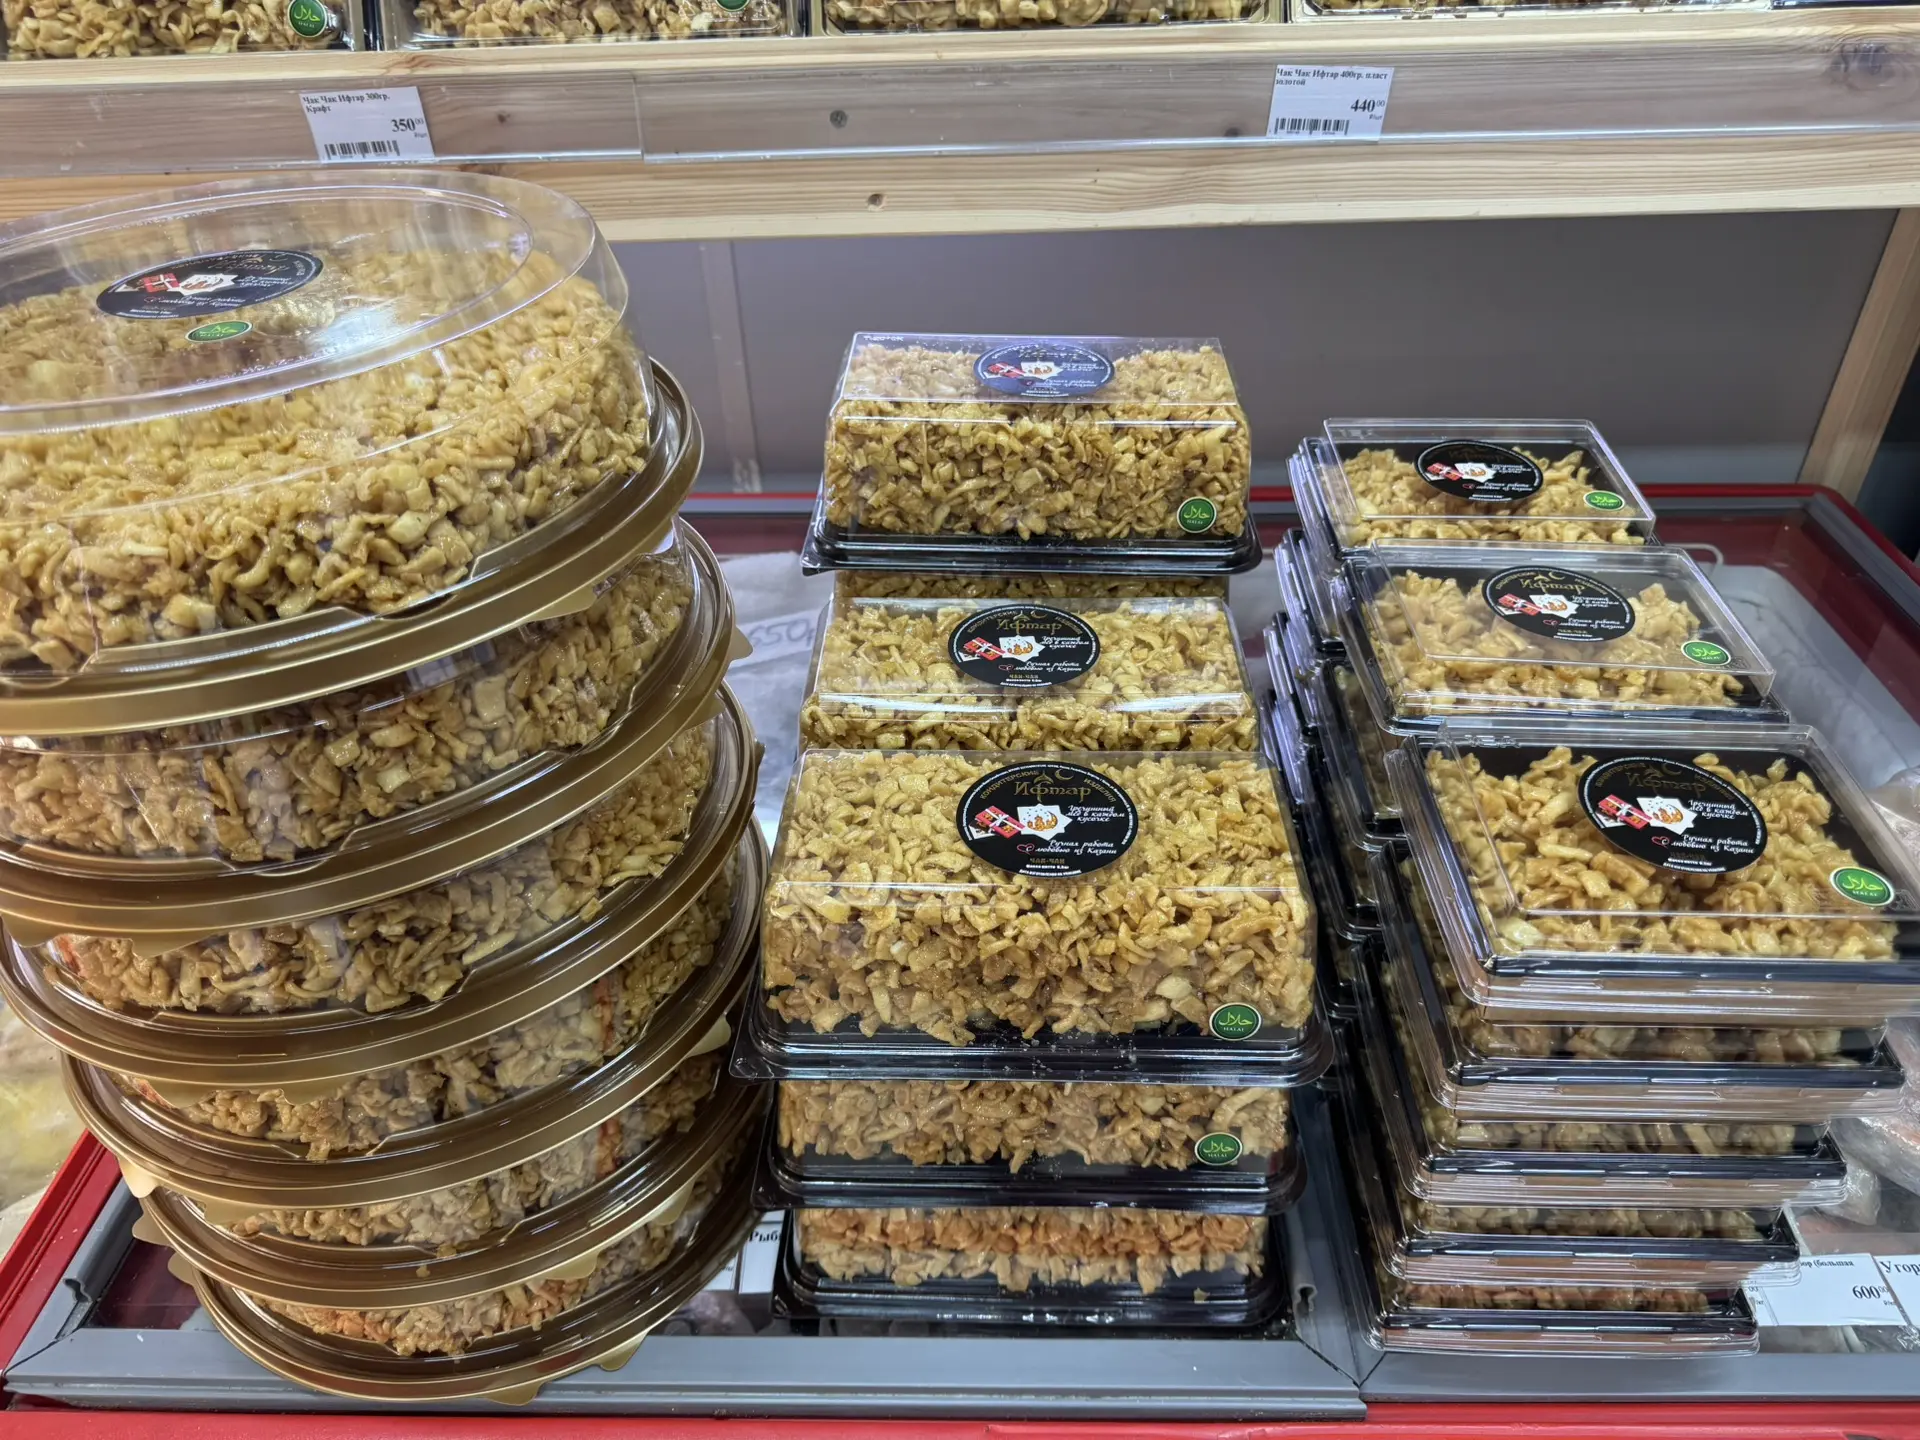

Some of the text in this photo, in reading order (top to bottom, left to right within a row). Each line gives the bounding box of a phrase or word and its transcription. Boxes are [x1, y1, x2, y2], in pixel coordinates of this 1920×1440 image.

[1277, 68, 1293, 76] Чак
[1295, 69, 1311, 77] Чак
[1312, 69, 1339, 79] Ифтар
[302, 96, 319, 104] Чак
[320, 95, 337, 103] Чак
[338, 94, 365, 104] Ифтар
[1350, 98, 1376, 113] 440
[306, 105, 331, 114] Крафт
[391, 117, 416, 132] 350
[1520, 578, 1586, 595] Ифтар
[996, 618, 1062, 636] Ифтар
[1624, 771, 1707, 798] Ифтар
[1013, 781, 1092, 803] Ифтар
[1049, 839, 1114, 849] Ручная работа
[1682, 834, 1749, 848] Ручная работа
[1087, 847, 1117, 856] Казани
[1723, 845, 1755, 855] Казани
[1842, 875, 1884, 891] حلال
[1218, 1011, 1253, 1026] حلال
[1203, 1140, 1235, 1153] حلال
[1813, 1258, 1855, 1269] (большая
[1852, 1285, 1881, 1299] 600
